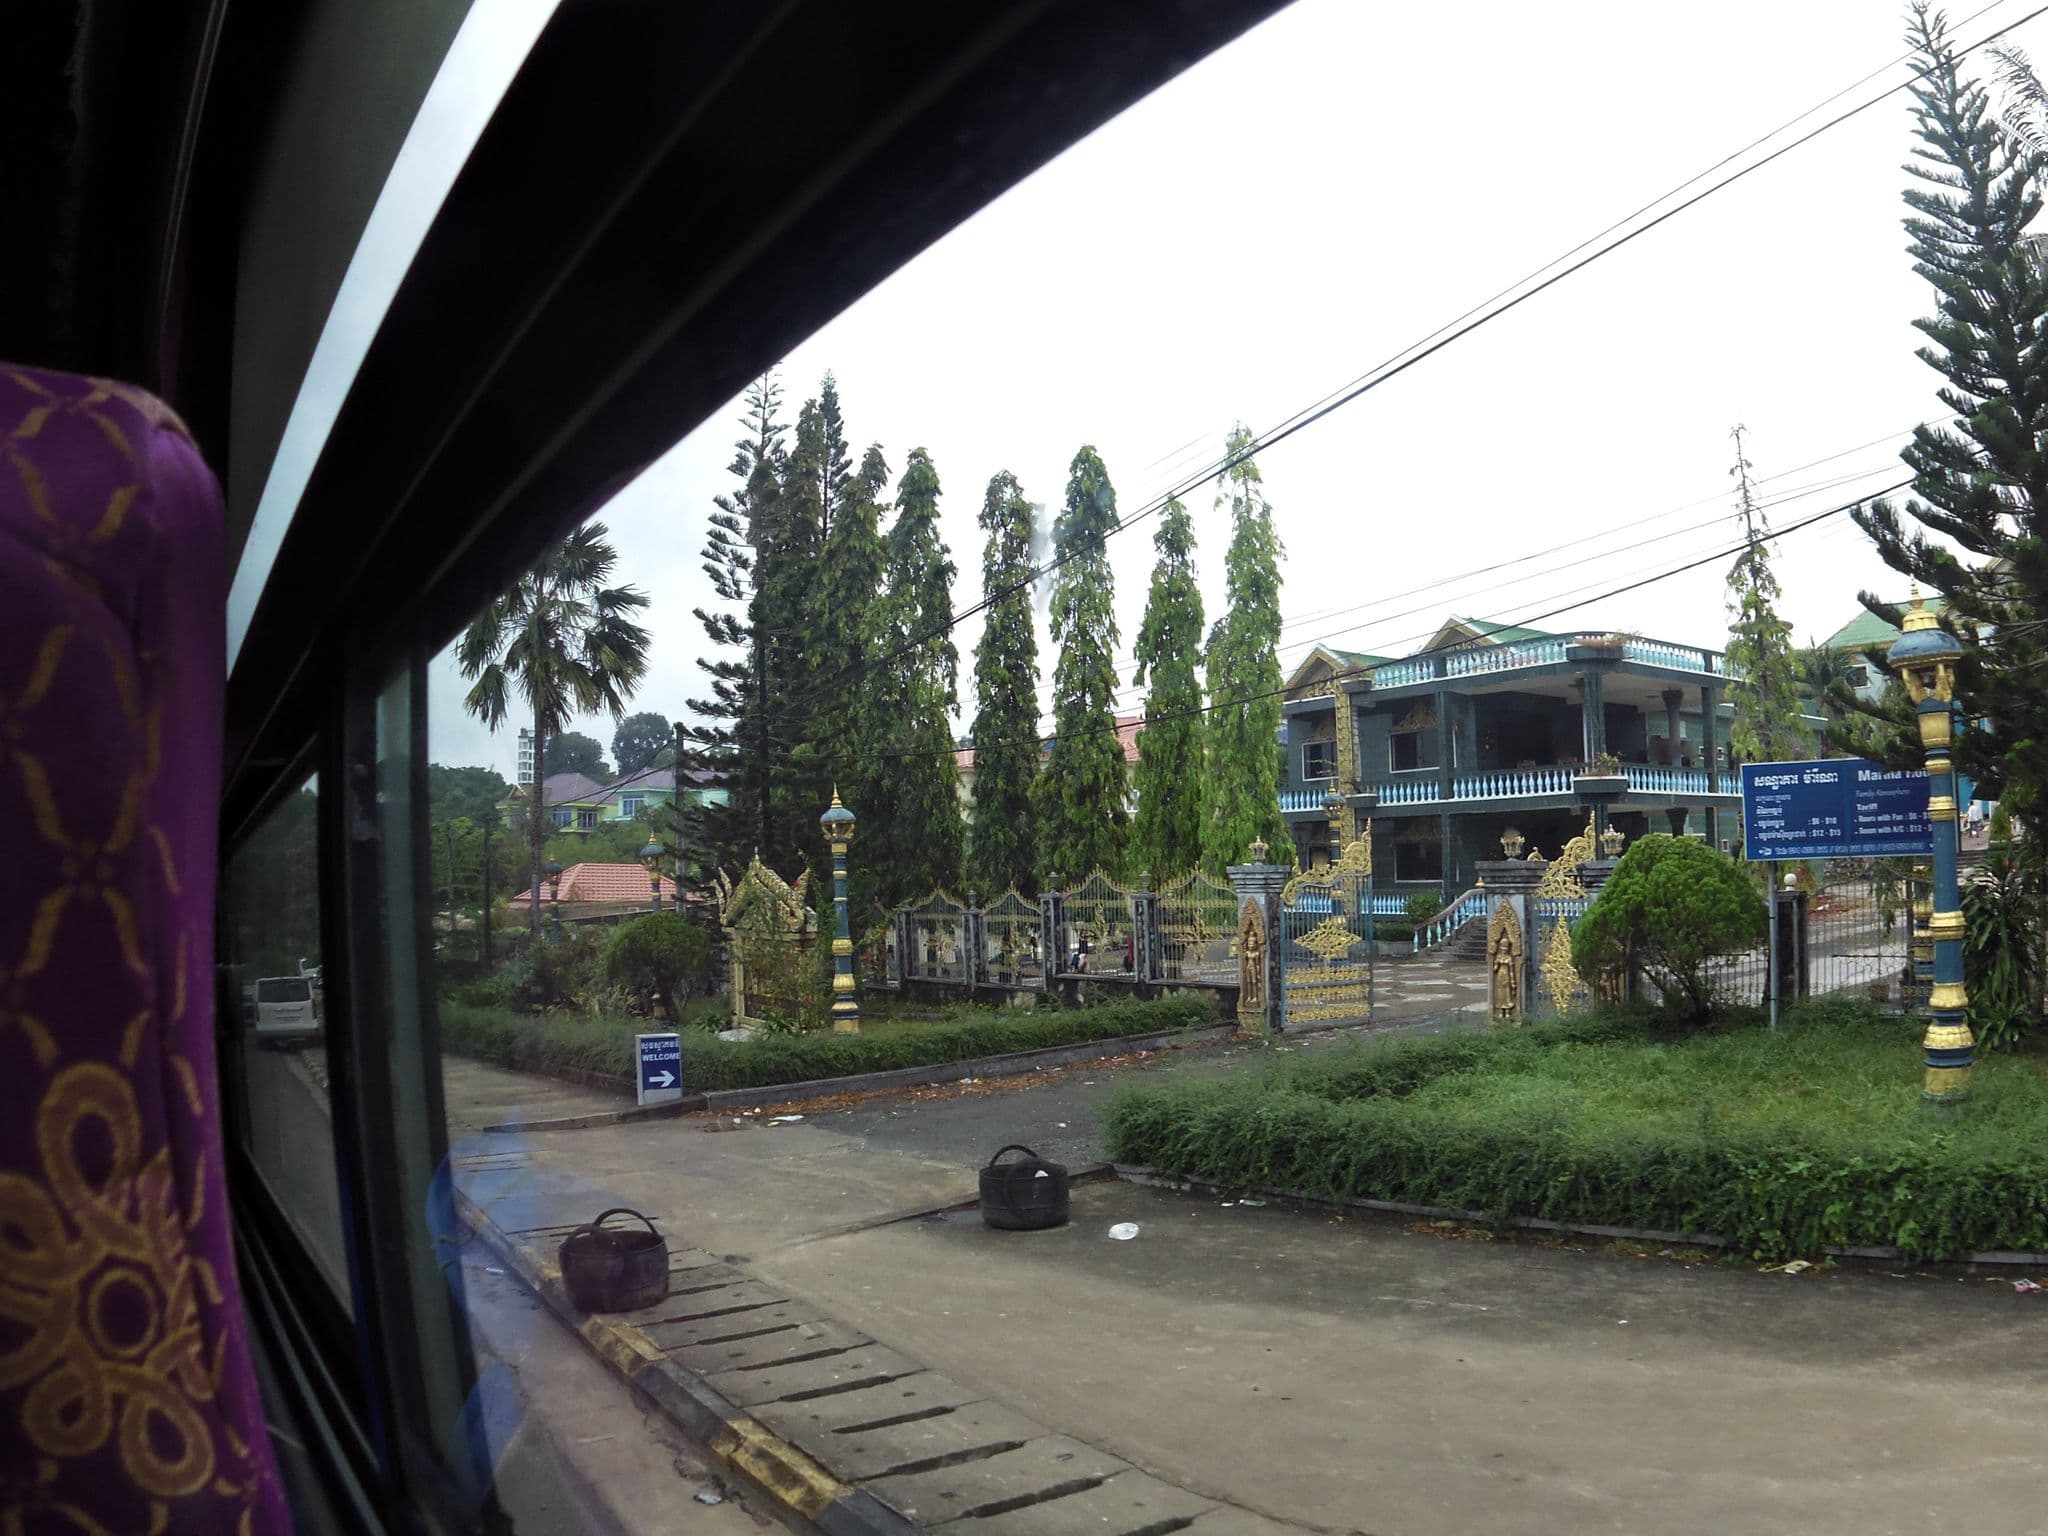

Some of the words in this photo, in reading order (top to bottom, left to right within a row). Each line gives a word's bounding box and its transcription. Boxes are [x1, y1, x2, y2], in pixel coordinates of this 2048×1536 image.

[1856, 802, 1878, 811] Tariff
[1825, 817, 1837, 825] $10
[1877, 814, 1891, 822] with
[1892, 813, 1904, 821] Fan
[1812, 829, 1825, 837] $12
[1877, 826, 1892, 834] with
[1892, 825, 1904, 833] A/C
[1909, 824, 1922, 833] $12
[642, 1052, 681, 1062] WELCOME
